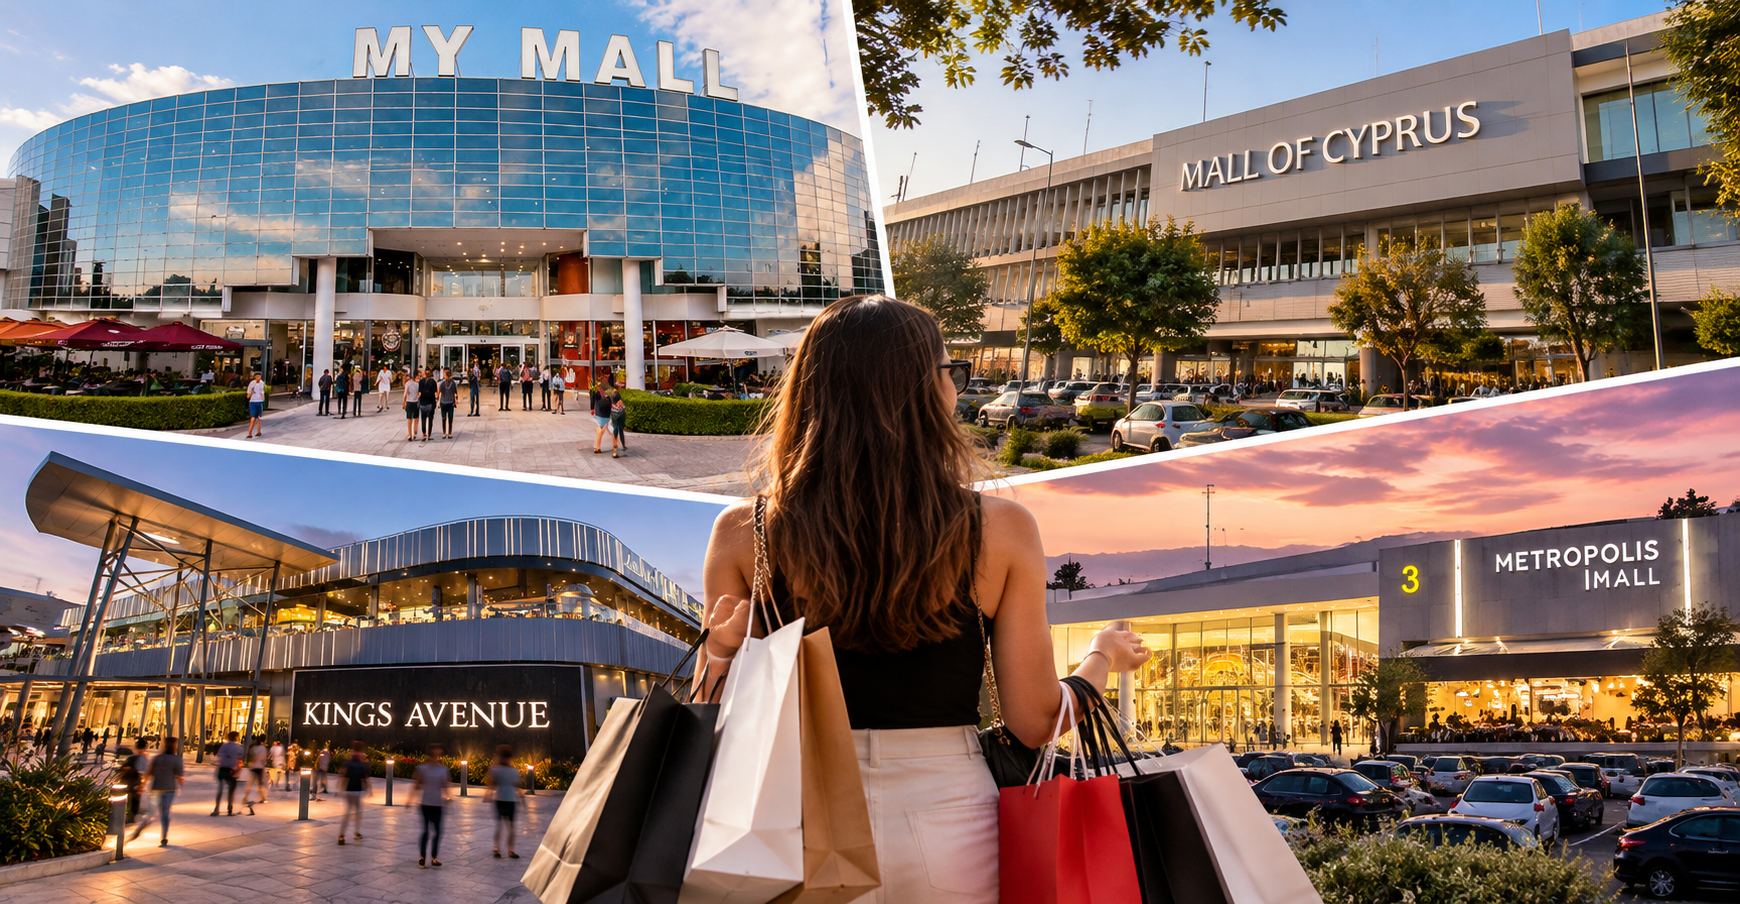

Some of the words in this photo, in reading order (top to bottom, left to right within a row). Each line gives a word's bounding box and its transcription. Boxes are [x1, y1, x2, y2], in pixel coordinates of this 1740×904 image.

[353, 25, 474, 78] MY
[521, 27, 738, 101] MALL
[1180, 150, 1260, 192] MALL
[1267, 136, 1316, 174] OF
[1322, 101, 1481, 163] CYPRUS
[1495, 540, 1659, 573] METROPOLIS
[1401, 565, 1420, 593] 3
[303, 702, 393, 727] KINGS
[405, 701, 550, 728] AVENUE
